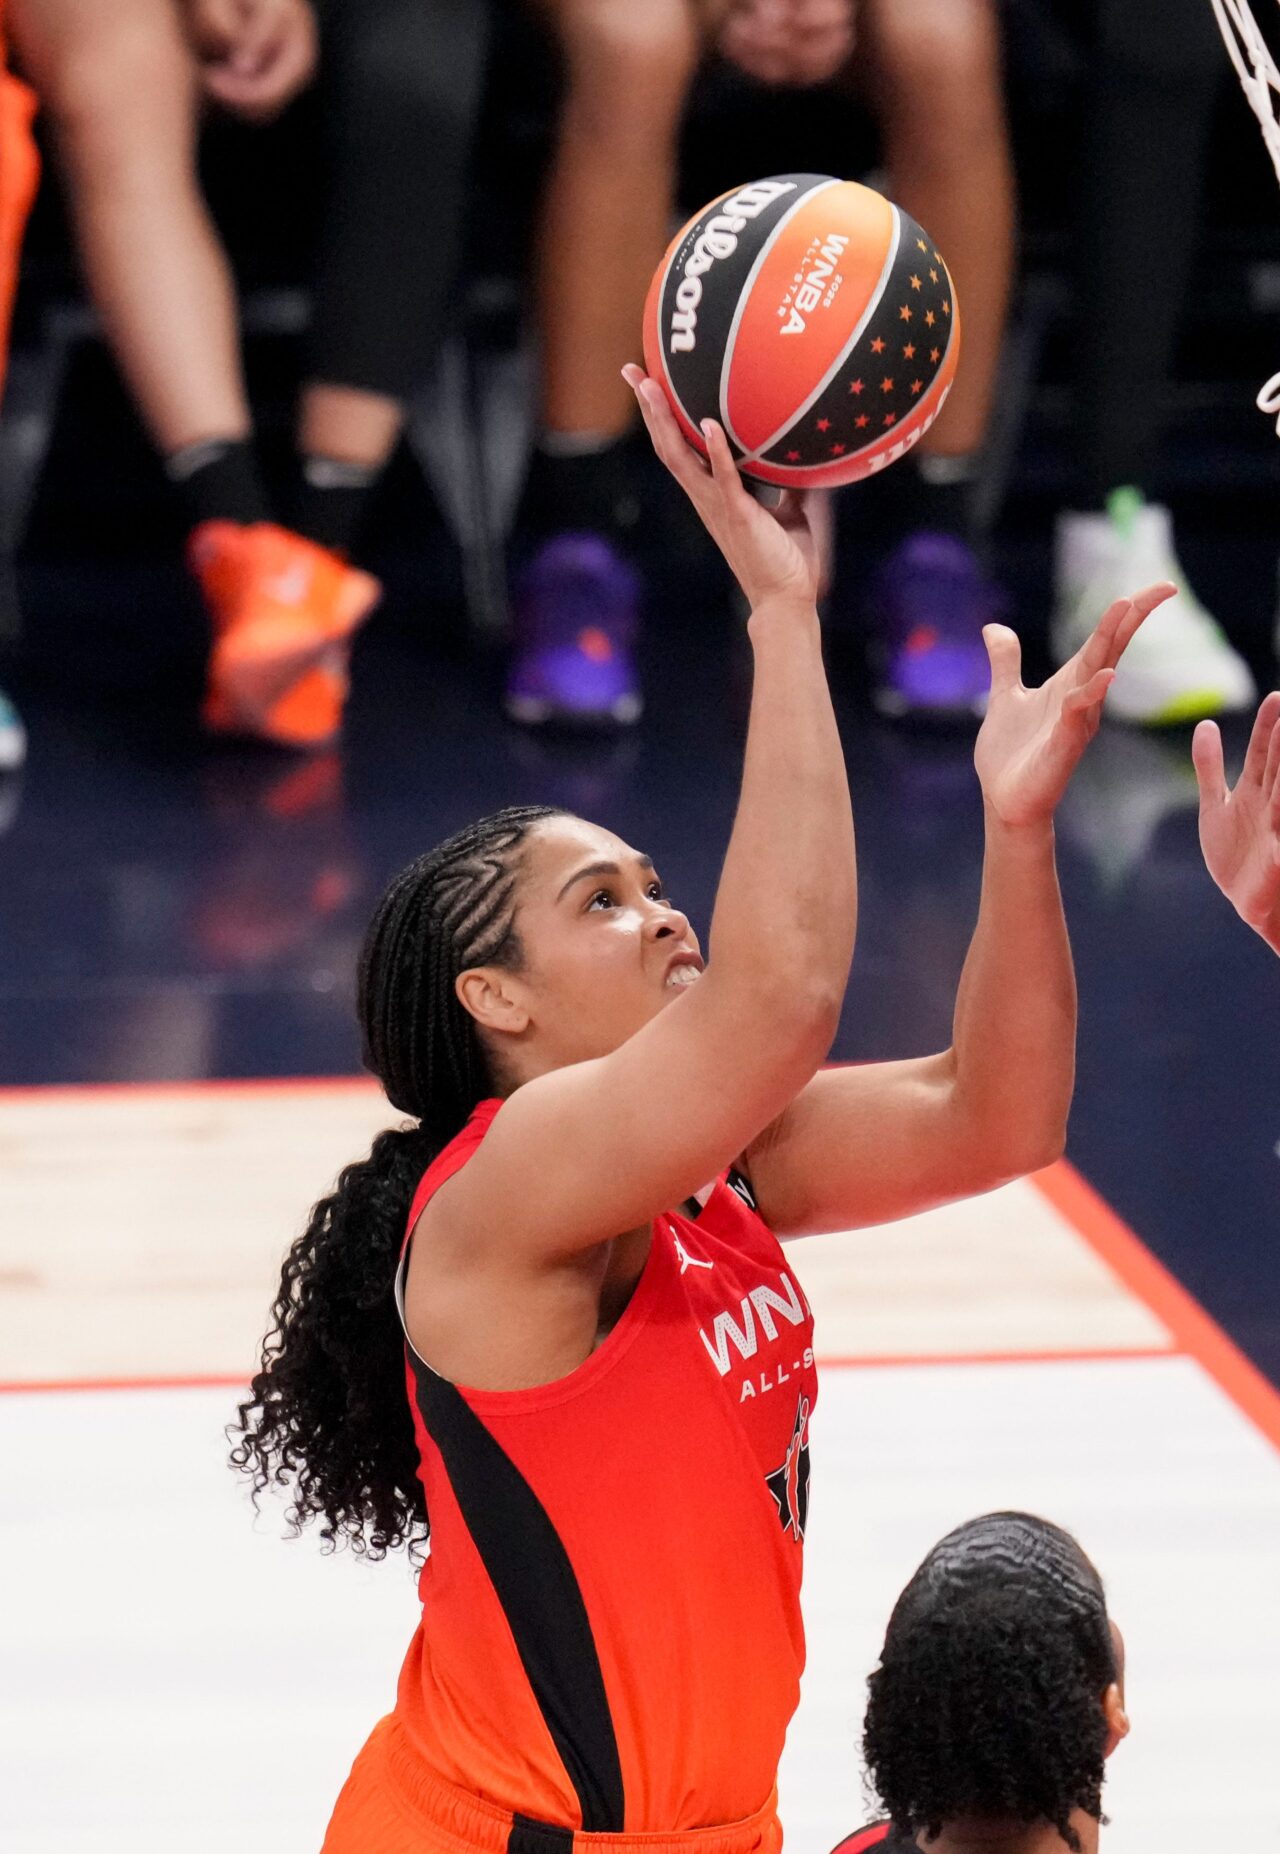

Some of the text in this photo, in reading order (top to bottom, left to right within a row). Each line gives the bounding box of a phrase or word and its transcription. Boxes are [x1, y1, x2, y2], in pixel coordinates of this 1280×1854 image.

[670, 181, 798, 354] Wilson
[776, 237, 821, 318] ALL-STAR
[779, 233, 850, 335] WNBA
[699, 1272, 811, 1377] WN
